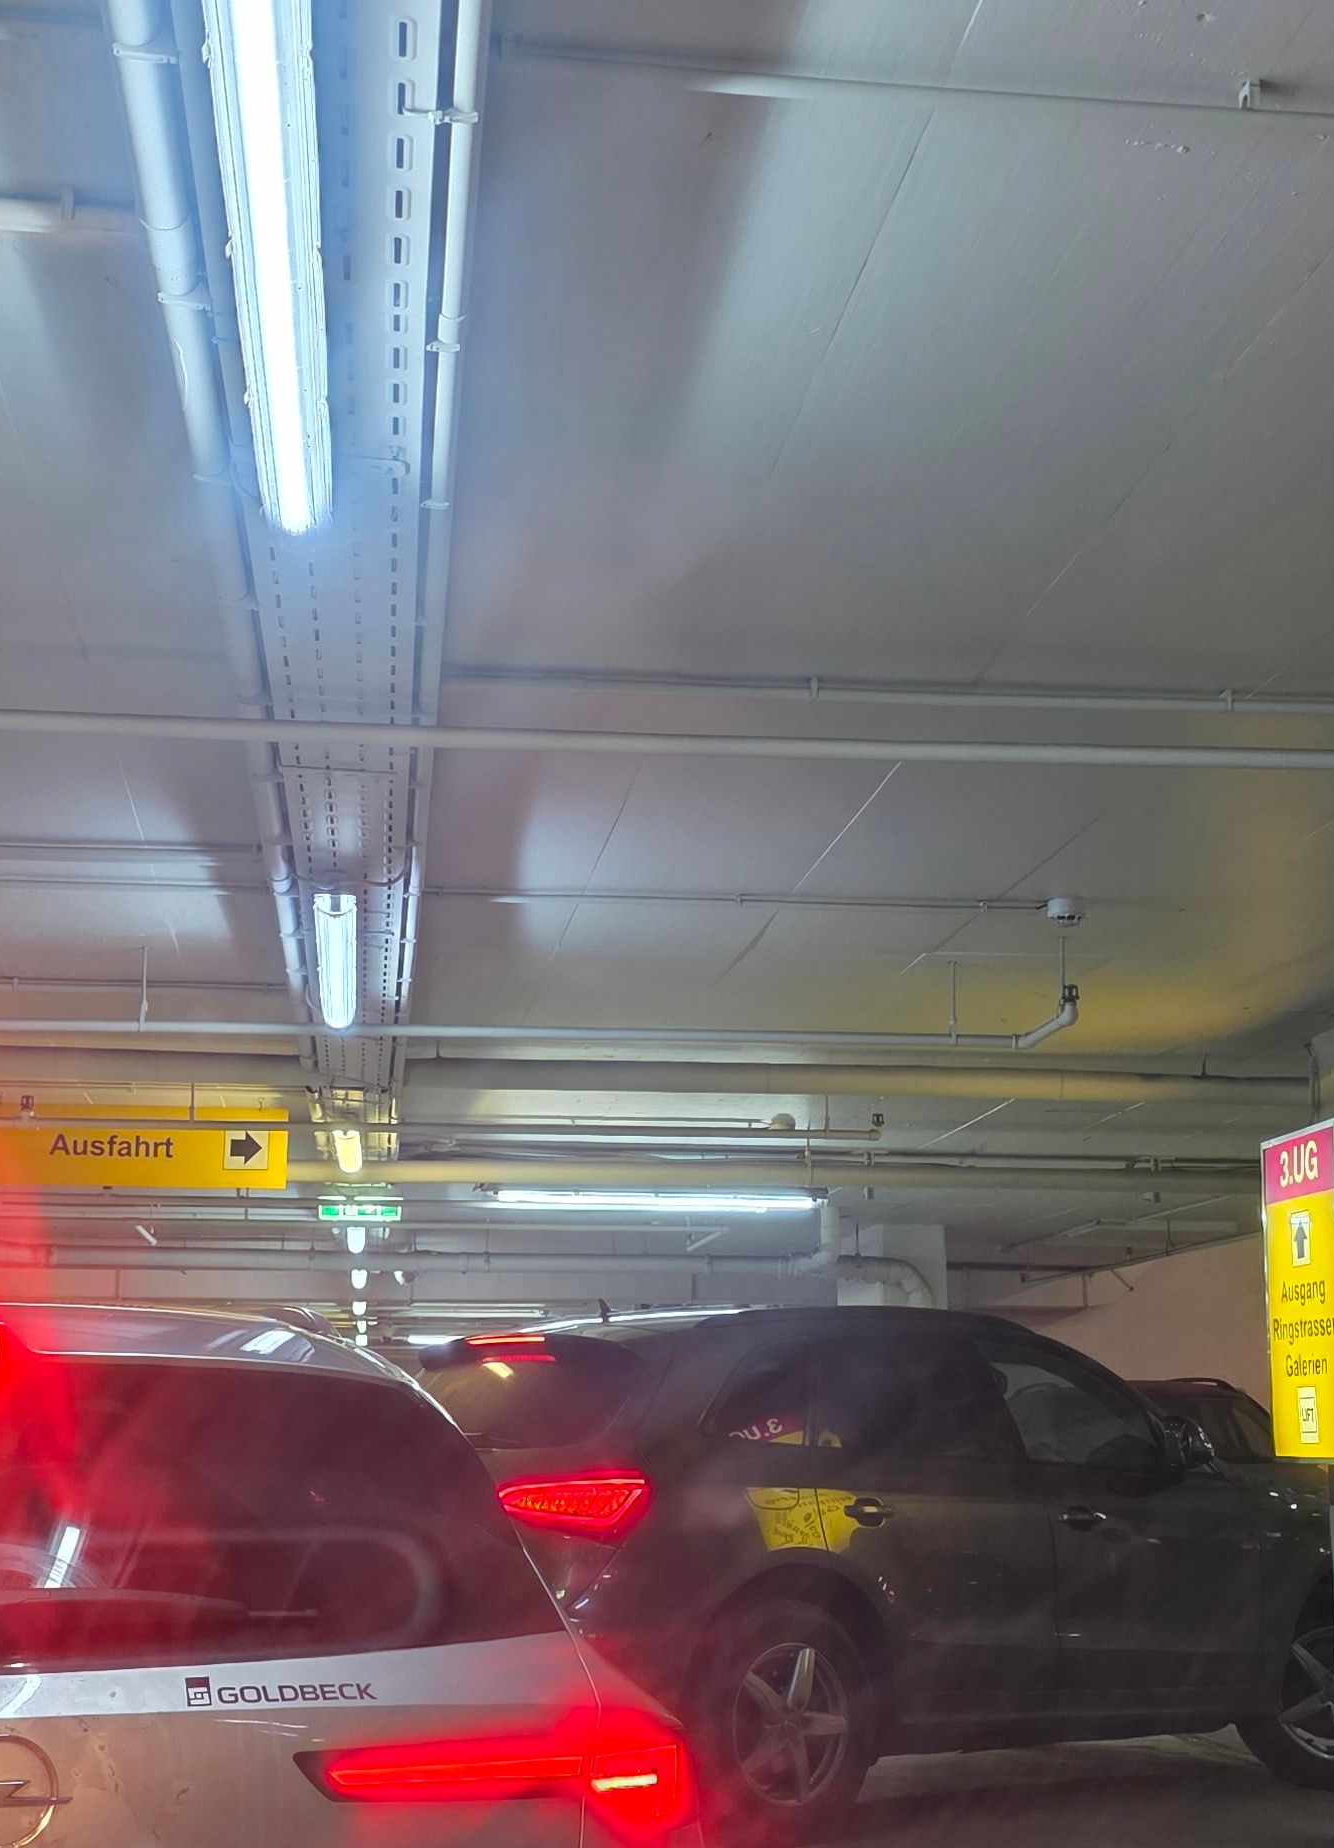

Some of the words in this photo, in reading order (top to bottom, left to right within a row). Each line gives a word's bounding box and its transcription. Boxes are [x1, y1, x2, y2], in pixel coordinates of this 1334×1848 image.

[48, 1132, 174, 1159] Ausfahrt
[1279, 1140, 1319, 1188] 3.UG
[1281, 1279, 1326, 1307] Ausgang
[1285, 1353, 1328, 1378] Galerien
[217, 1683, 377, 1704] GOLDBECK
